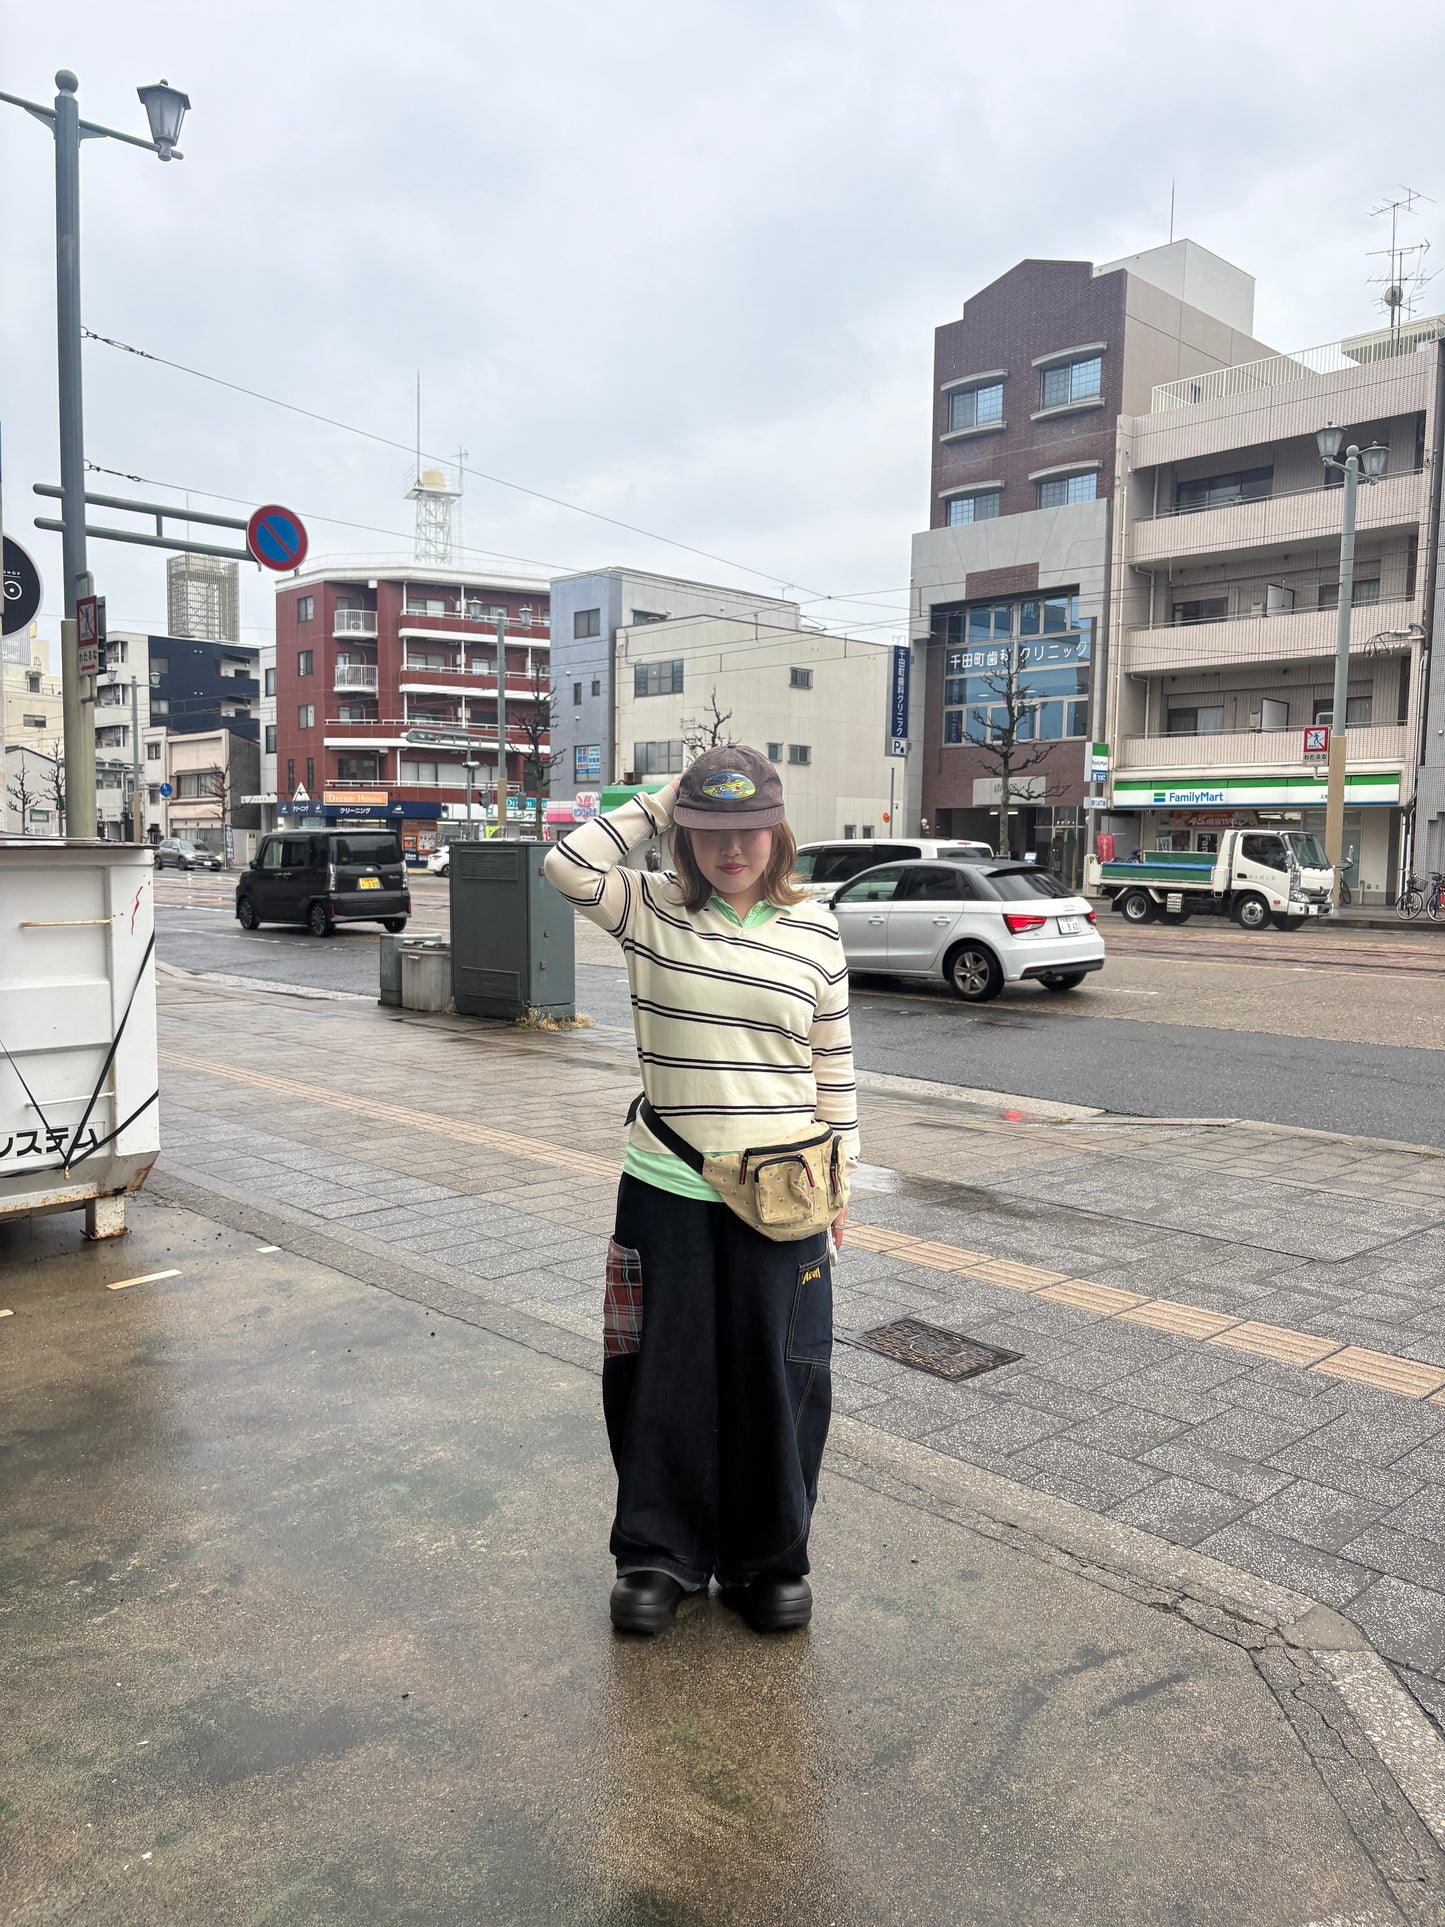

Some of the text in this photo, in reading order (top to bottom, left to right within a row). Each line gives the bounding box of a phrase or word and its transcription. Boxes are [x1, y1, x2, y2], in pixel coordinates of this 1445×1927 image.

[79, 650, 98, 662] わたるな
[893, 740, 901, 753] P
[1303, 753, 1328, 761] わたるな
[328, 793, 383, 803] Dream House
[1169, 791, 1224, 804] FamilyMart
[339, 807, 371, 815] クリーニング
